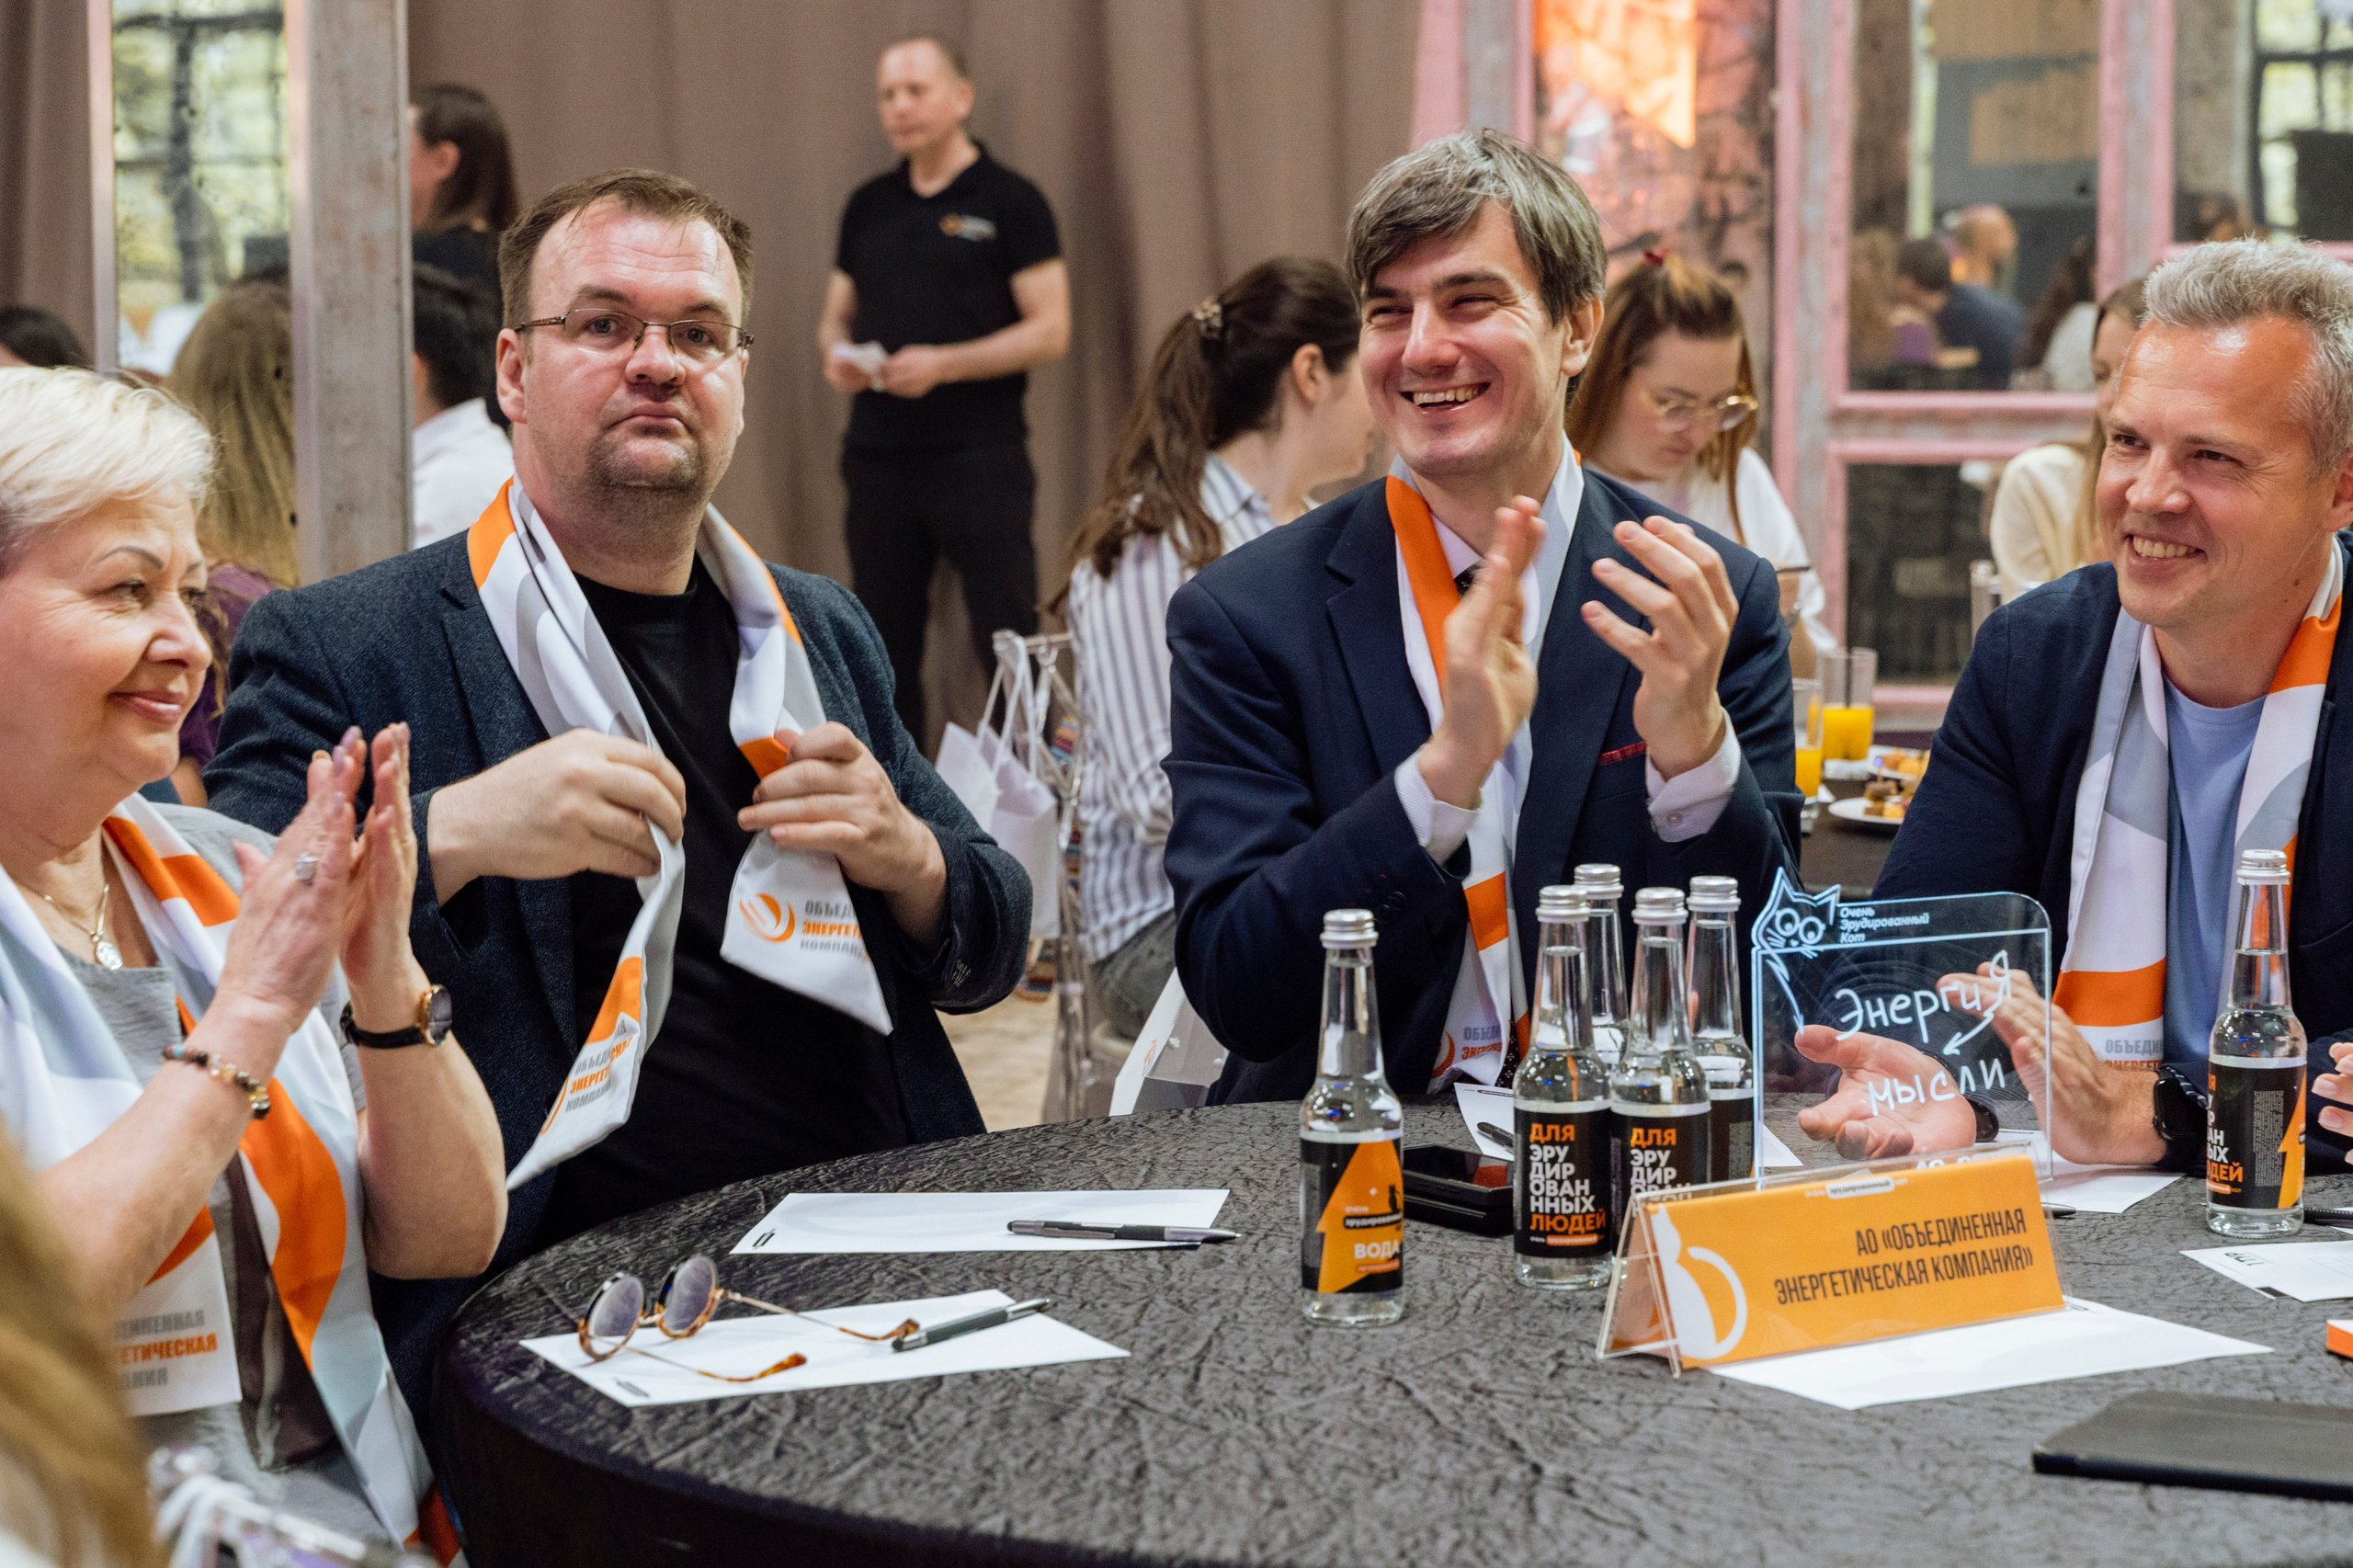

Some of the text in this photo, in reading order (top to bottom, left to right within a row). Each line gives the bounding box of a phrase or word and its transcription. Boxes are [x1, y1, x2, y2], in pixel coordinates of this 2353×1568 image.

[1839, 906, 1875, 918] Очень
[1839, 913, 1930, 933] Эрудированный
[1839, 933, 1866, 944] Кот
[2105, 1039, 2164, 1056] ОБЪЕДИ
[1529, 1122, 1575, 1143] ДЛЯ
[1630, 1127, 1677, 1148] ДЛЯ
[1529, 1144, 1570, 1162] ЭРУ
[1630, 1148, 1671, 1167] ЭРУ
[1529, 1162, 1575, 1181] ДИР
[1630, 1166, 1677, 1187] ДИР
[1529, 1179, 1590, 1197] ОВАН
[1529, 1196, 1596, 1214] ННЫХ
[1529, 1208, 1607, 1233] ЛЮДЕЙ
[1855, 1207, 2028, 1256] АО «ОБЪЕДИНЕННАЯ
[1774, 1244, 2034, 1305] ЭНЕРГЕТИЧЕСКАЯ КОМПАНИЯ»
